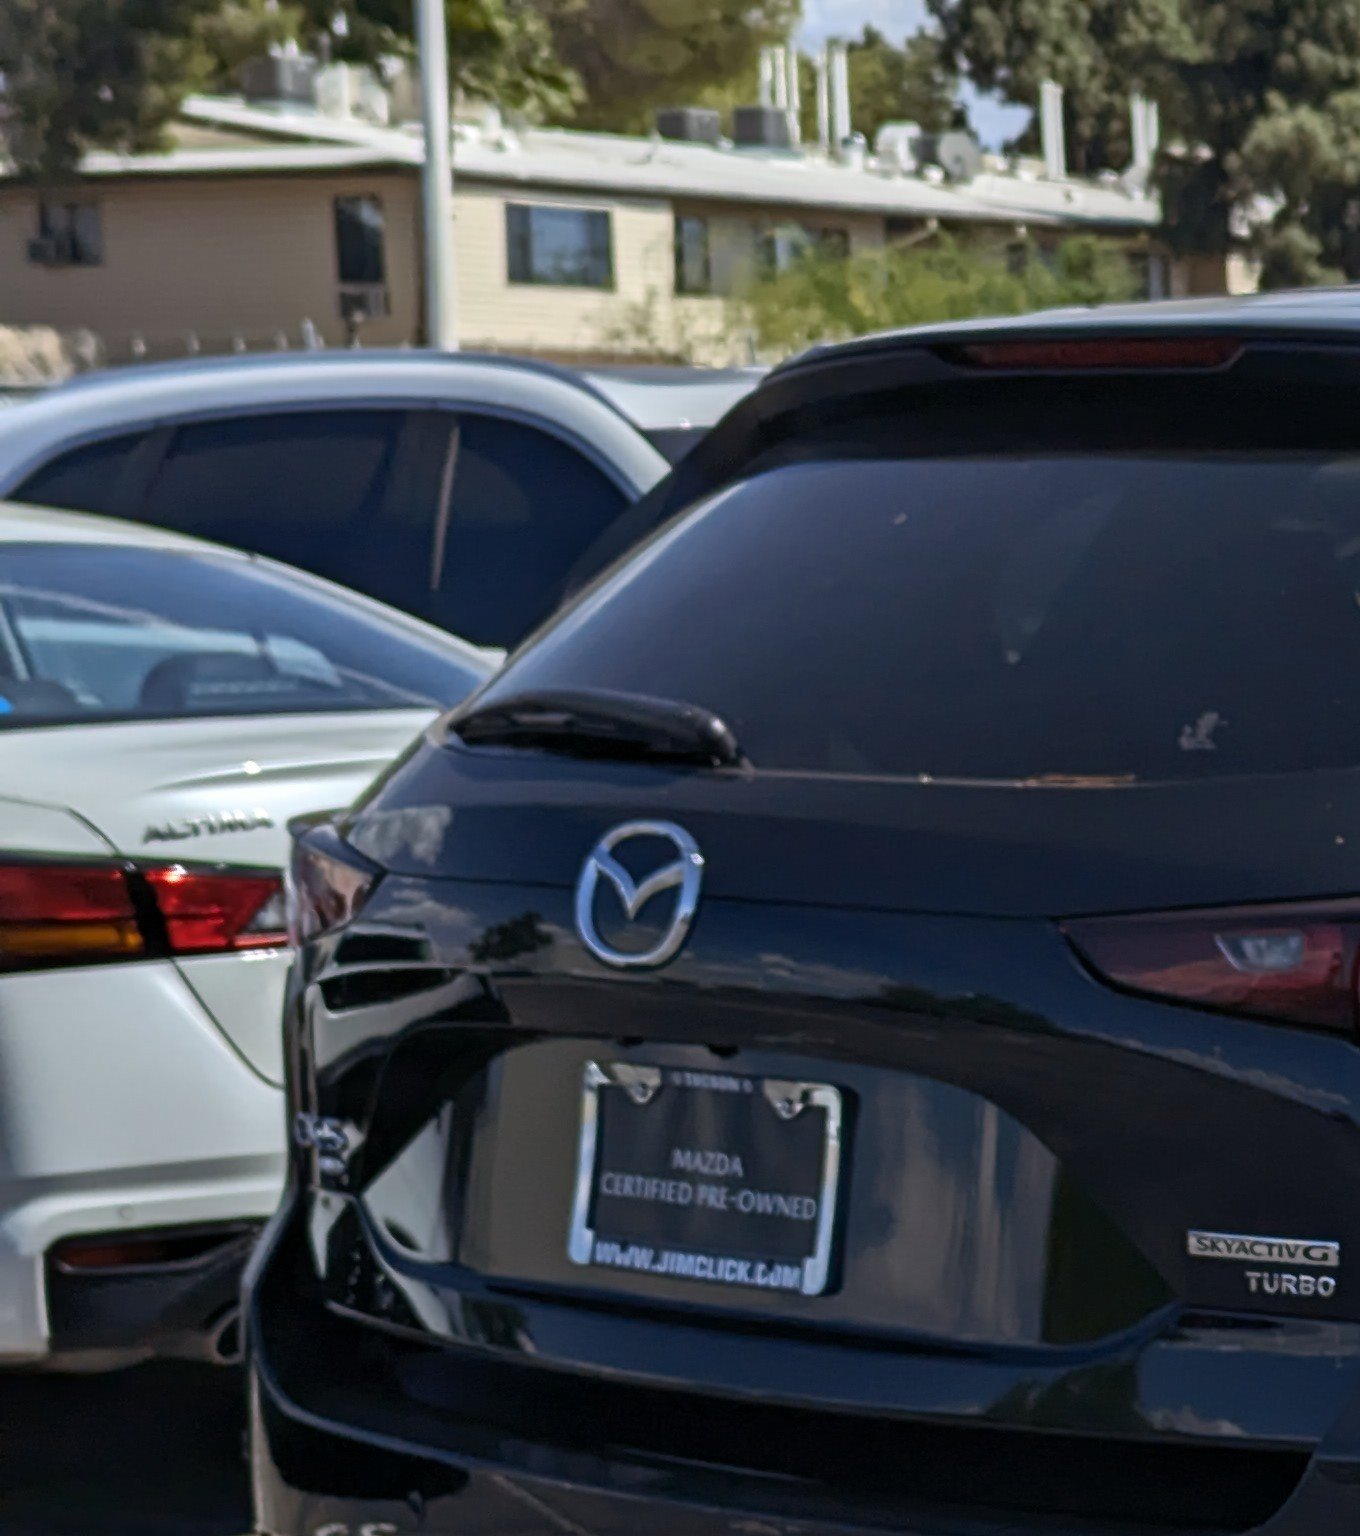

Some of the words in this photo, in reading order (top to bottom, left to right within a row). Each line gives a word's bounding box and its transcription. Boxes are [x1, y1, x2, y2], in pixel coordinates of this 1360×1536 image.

[672, 1149, 744, 1177] MAZDA
[601, 1173, 693, 1204] CERTIFIED
[698, 1185, 816, 1220] PRE-OWNED
[1245, 1270, 1337, 1298] TURBO
